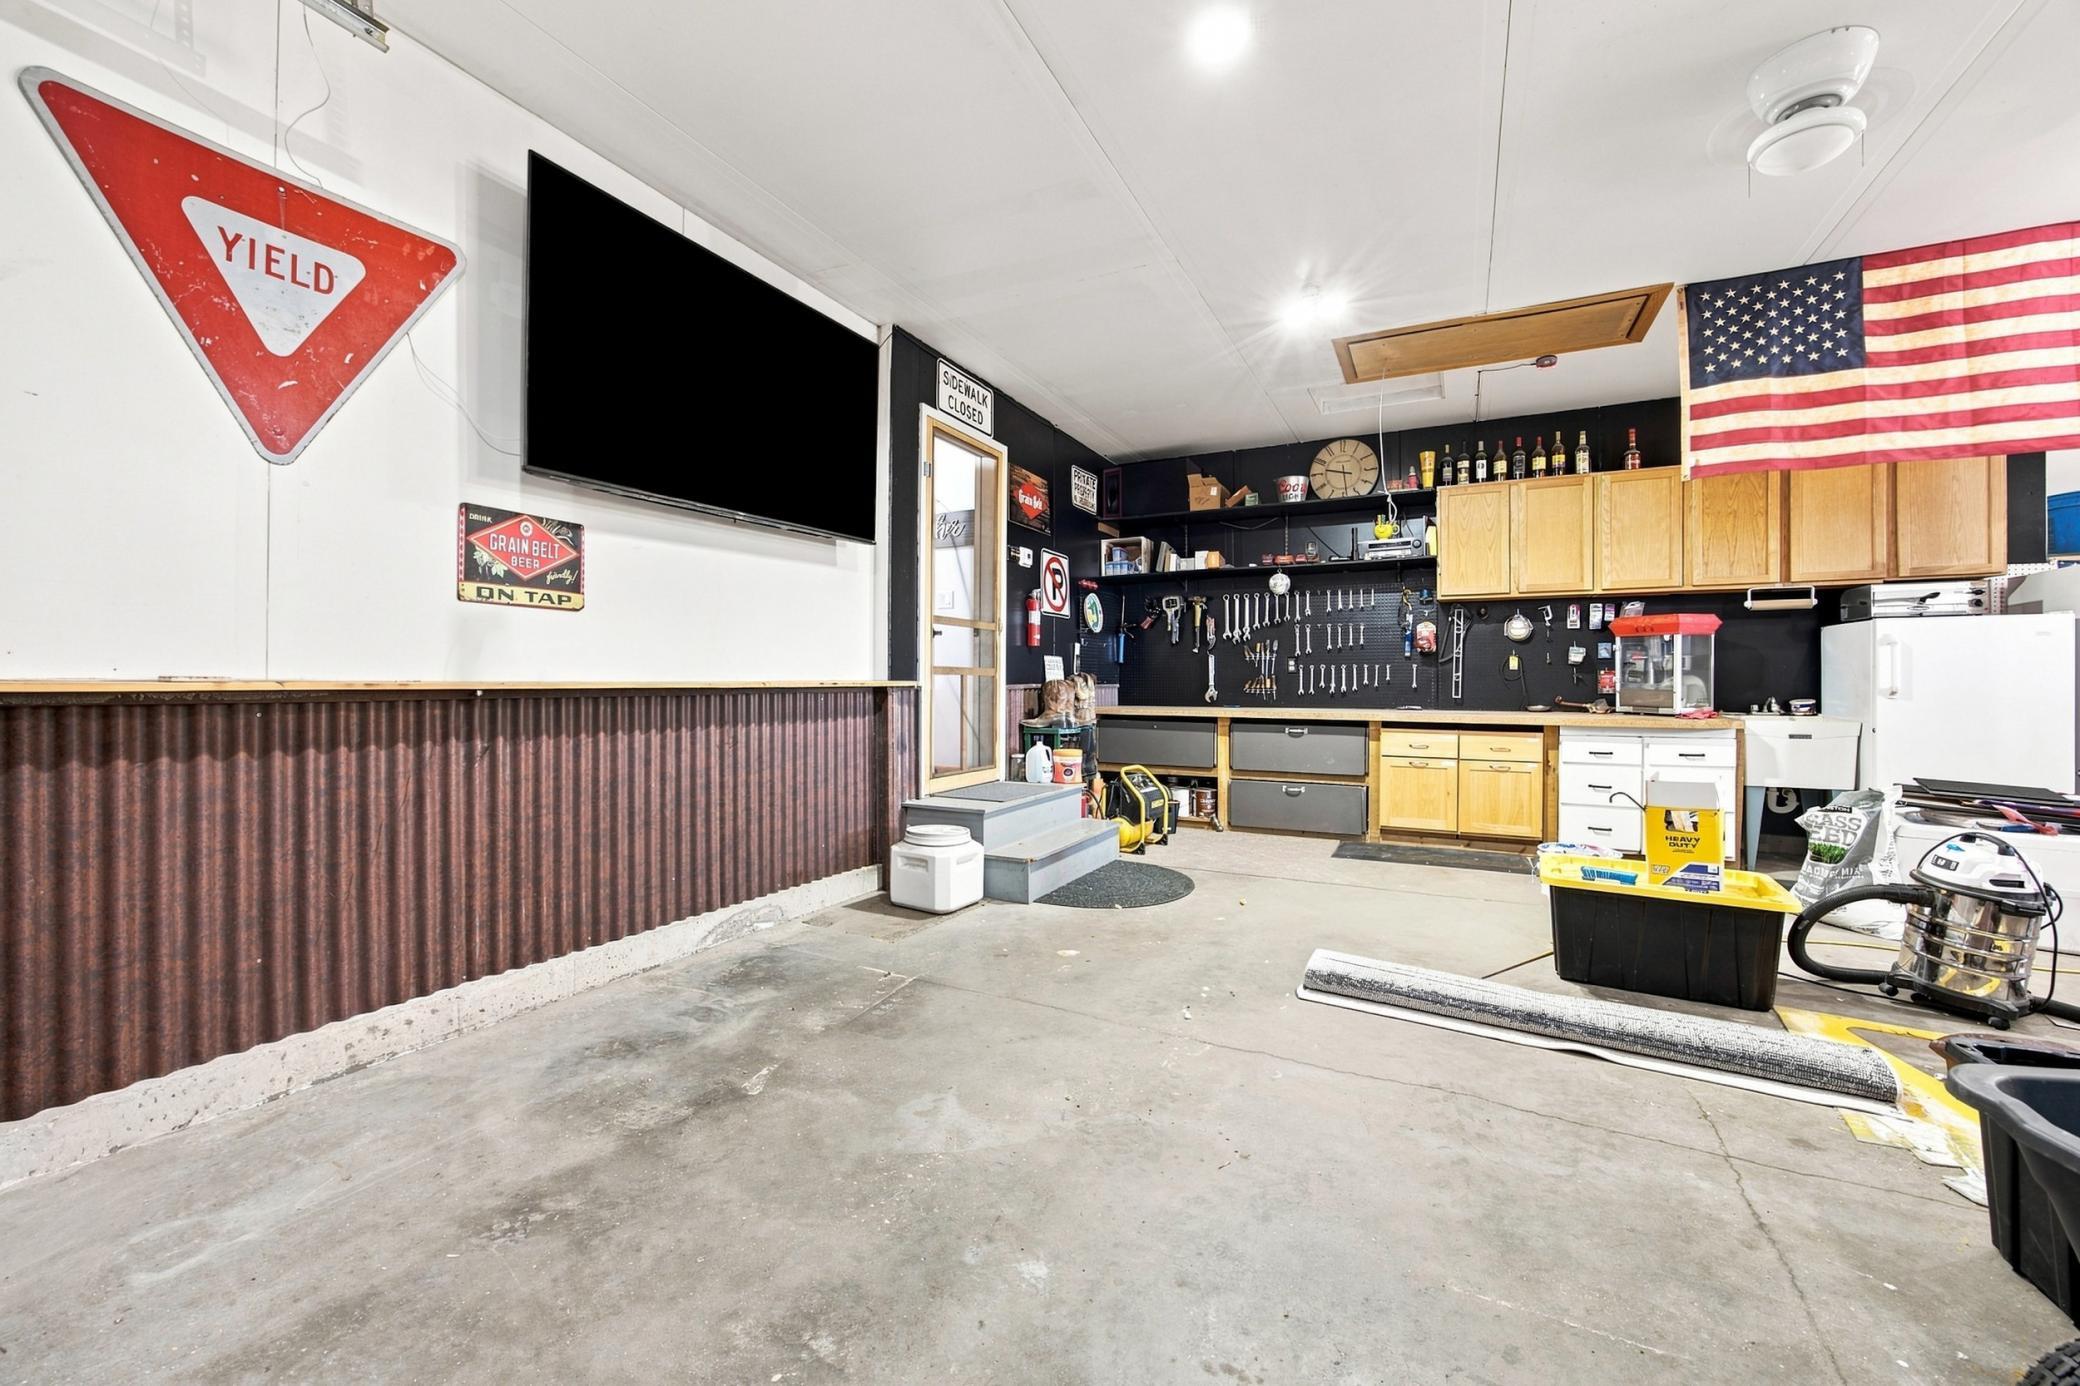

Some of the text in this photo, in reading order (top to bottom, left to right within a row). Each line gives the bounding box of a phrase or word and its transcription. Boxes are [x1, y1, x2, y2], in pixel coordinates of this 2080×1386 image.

[217, 225, 334, 295] YIELD
[943, 370, 988, 409] SIDEWALK
[948, 394, 984, 425] CLOSED
[1074, 469, 1096, 490] PRIVATE
[469, 513, 493, 523] DRINK
[489, 533, 560, 559] GRAIN BELT
[511, 555, 540, 569] BEER
[476, 586, 572, 605] ON TAP
[1665, 835, 1701, 843] HEAVY
[1668, 841, 1698, 849] DUTY
